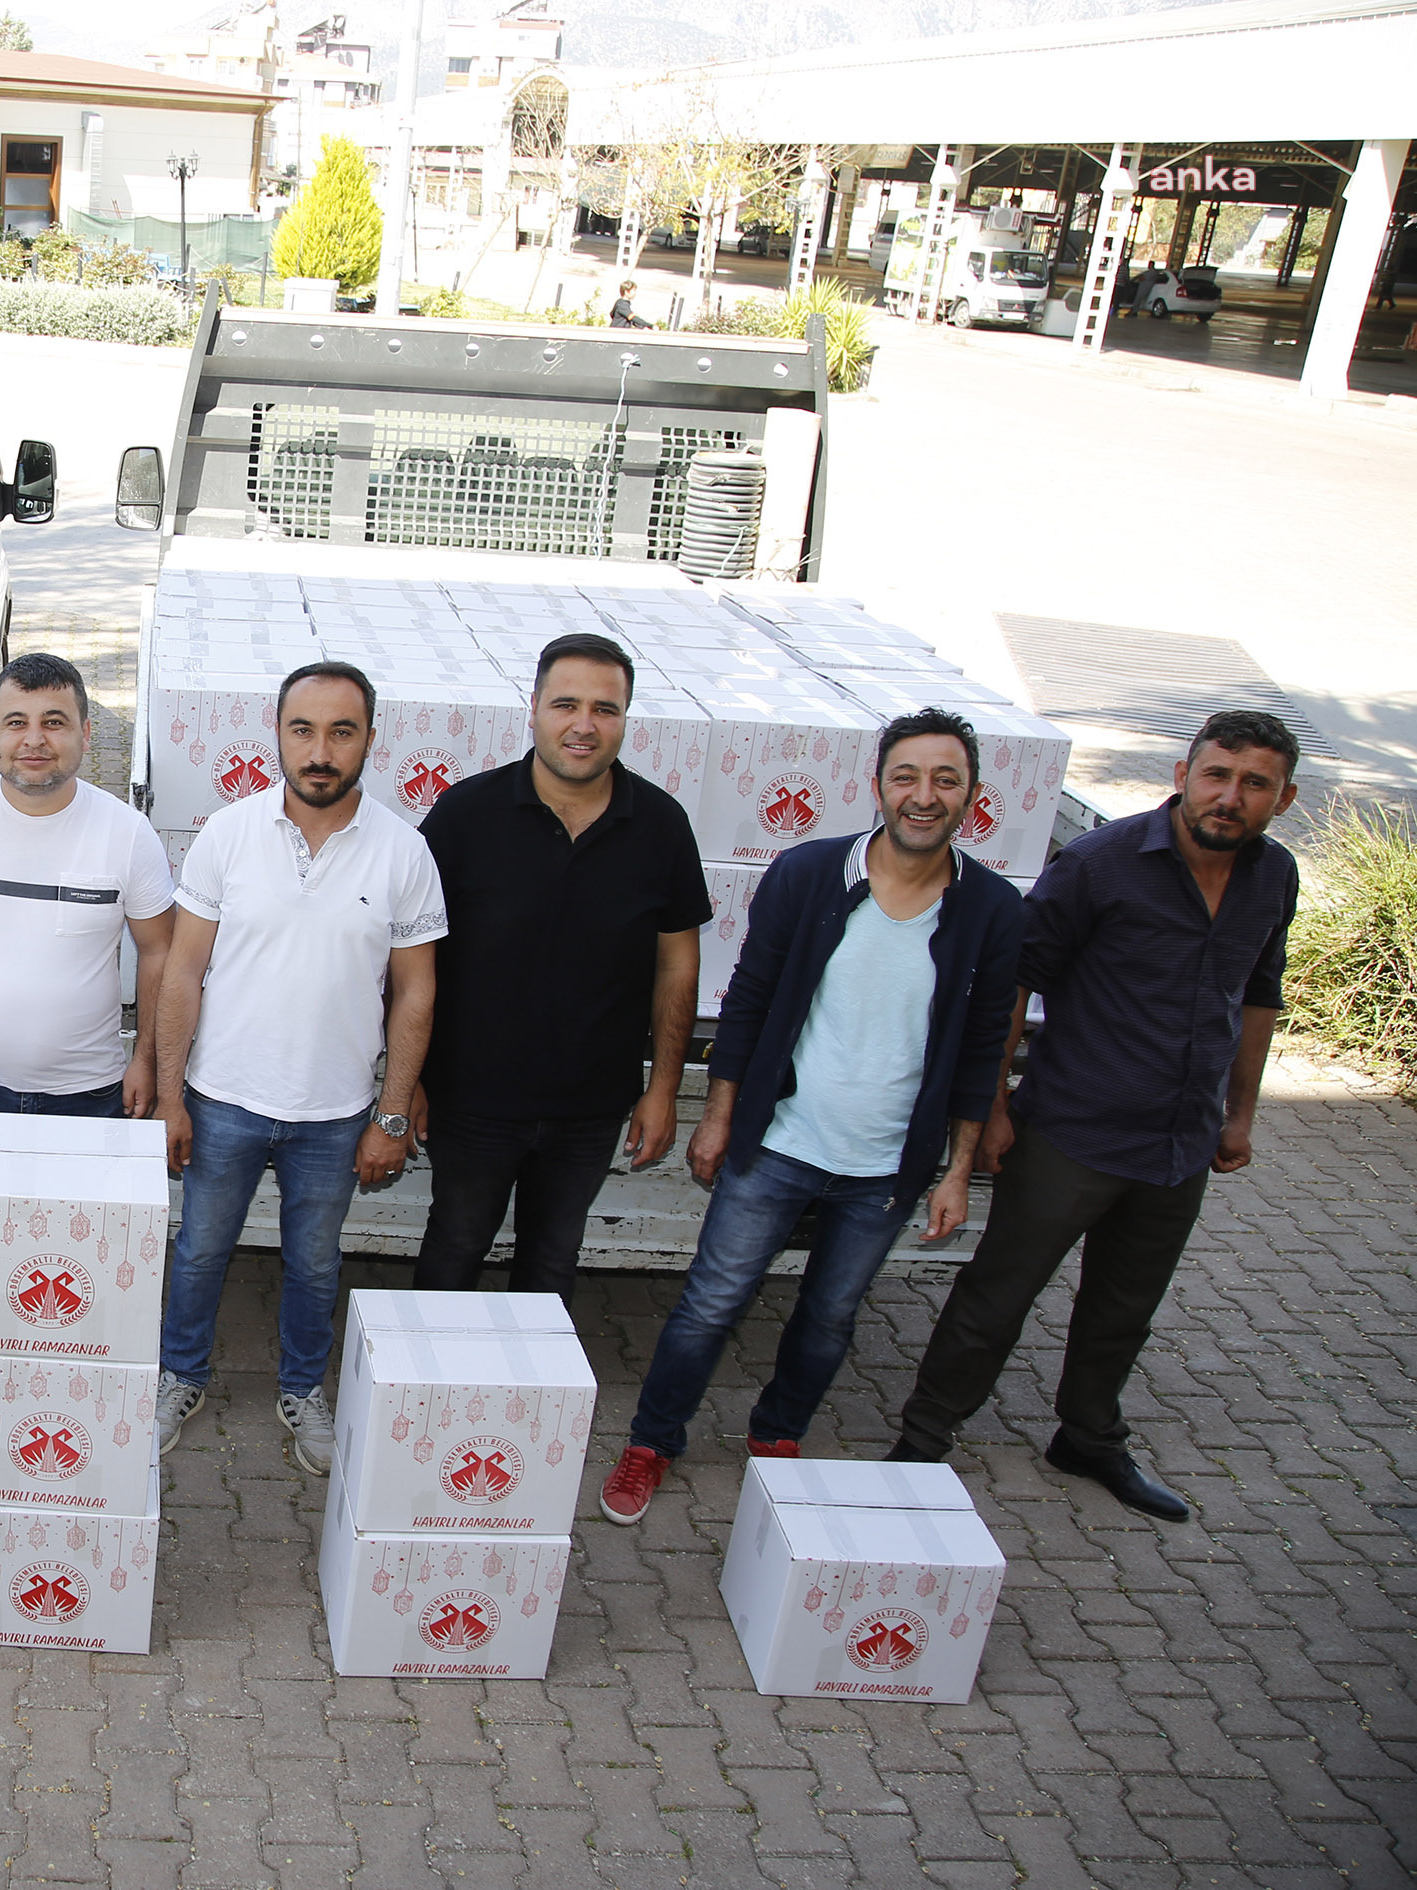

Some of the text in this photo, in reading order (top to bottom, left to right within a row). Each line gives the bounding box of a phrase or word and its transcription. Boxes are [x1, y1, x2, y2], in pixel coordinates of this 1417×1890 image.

[733, 847, 769, 859] HAYIRLI
[31, 1340, 110, 1356] RAMAZANLAR
[32, 1492, 107, 1508] RAMAZANLAR
[413, 1516, 535, 1529] HAYIRLI RAMAZANLAR
[33, 1634, 106, 1648] RAMAZANLAR
[392, 1663, 510, 1675] HAYIRLI RAMAZANLAR
[815, 1682, 933, 1697] HAYIRLI RAMAZANLAR
